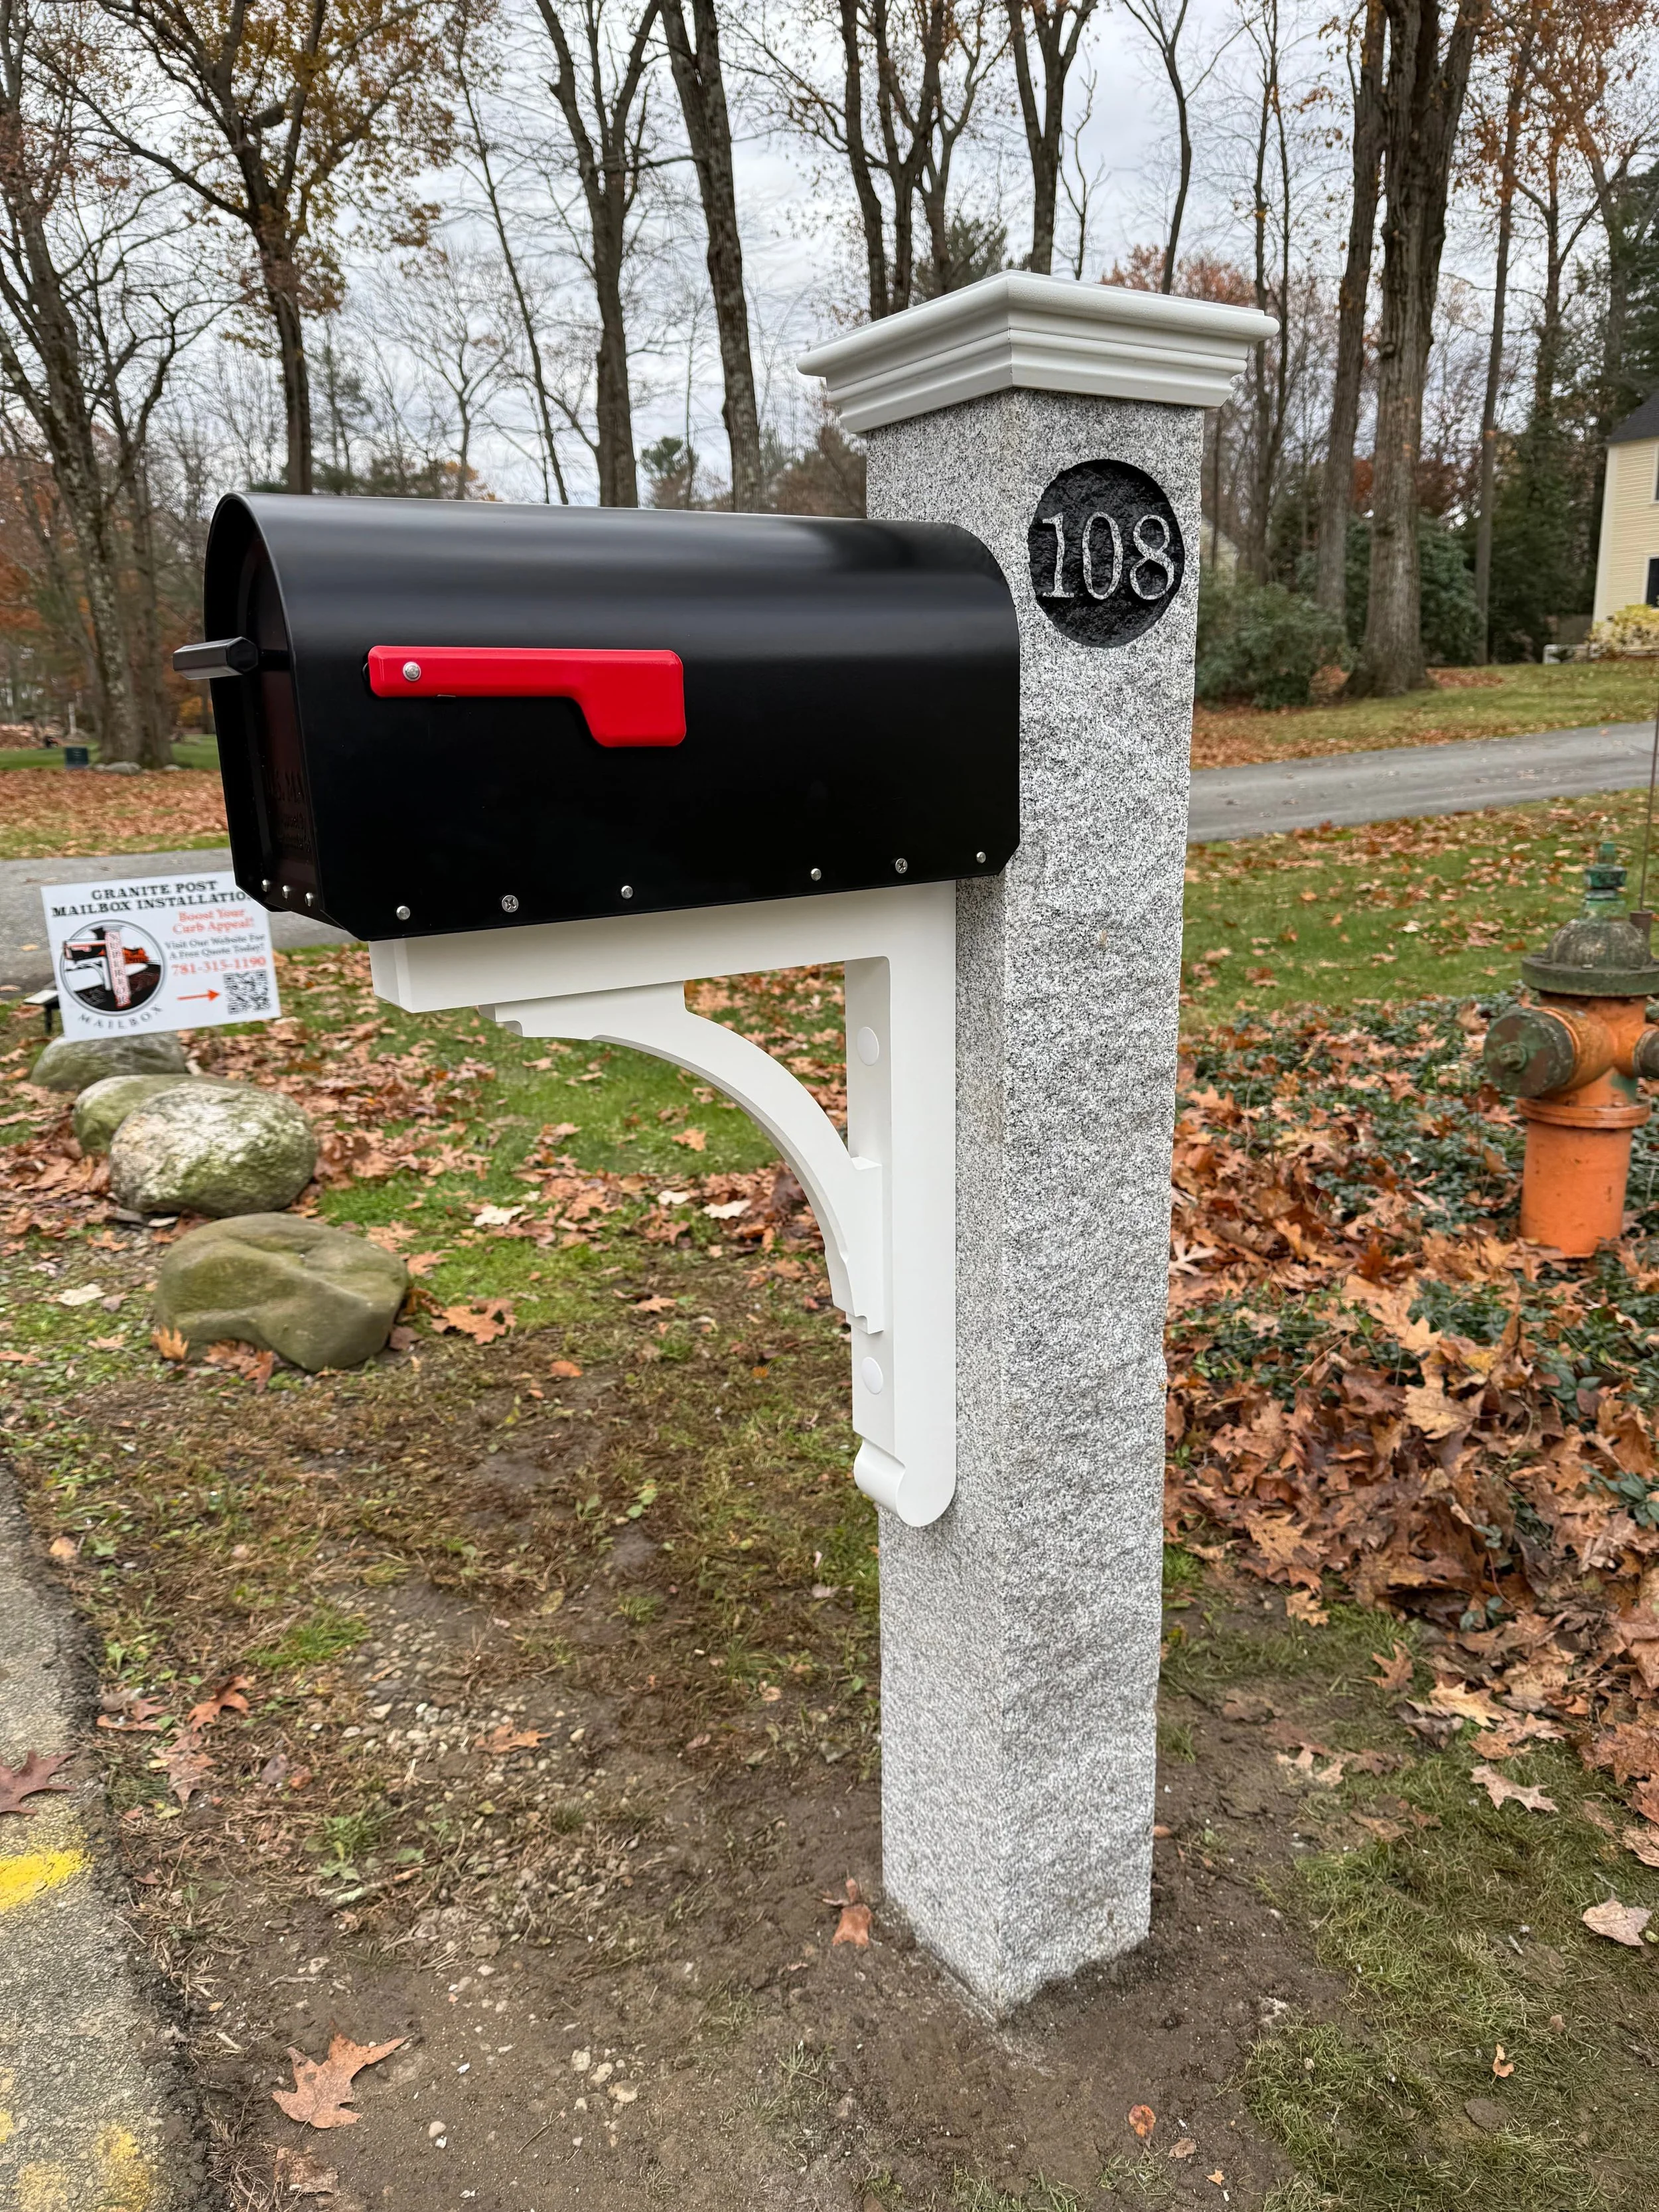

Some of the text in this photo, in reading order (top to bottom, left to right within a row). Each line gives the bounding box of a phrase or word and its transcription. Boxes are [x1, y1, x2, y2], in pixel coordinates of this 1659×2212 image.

[1042, 511, 1175, 600] 108
[92, 881, 216, 901] GRANITE POST
[52, 891, 251, 917] MAILBOX INSTALLATIO
[179, 909, 246, 922] Boost Your
[173, 918, 253, 934] Curb Appeal!
[165, 934, 264, 950] Visit Our Website For
[181, 950, 200, 958] Free
[202, 946, 231, 958] Quote
[234, 942, 263, 953] Today!
[172, 956, 266, 976] 781-315-1190
[78, 1005, 163, 1029] MAILBOX
